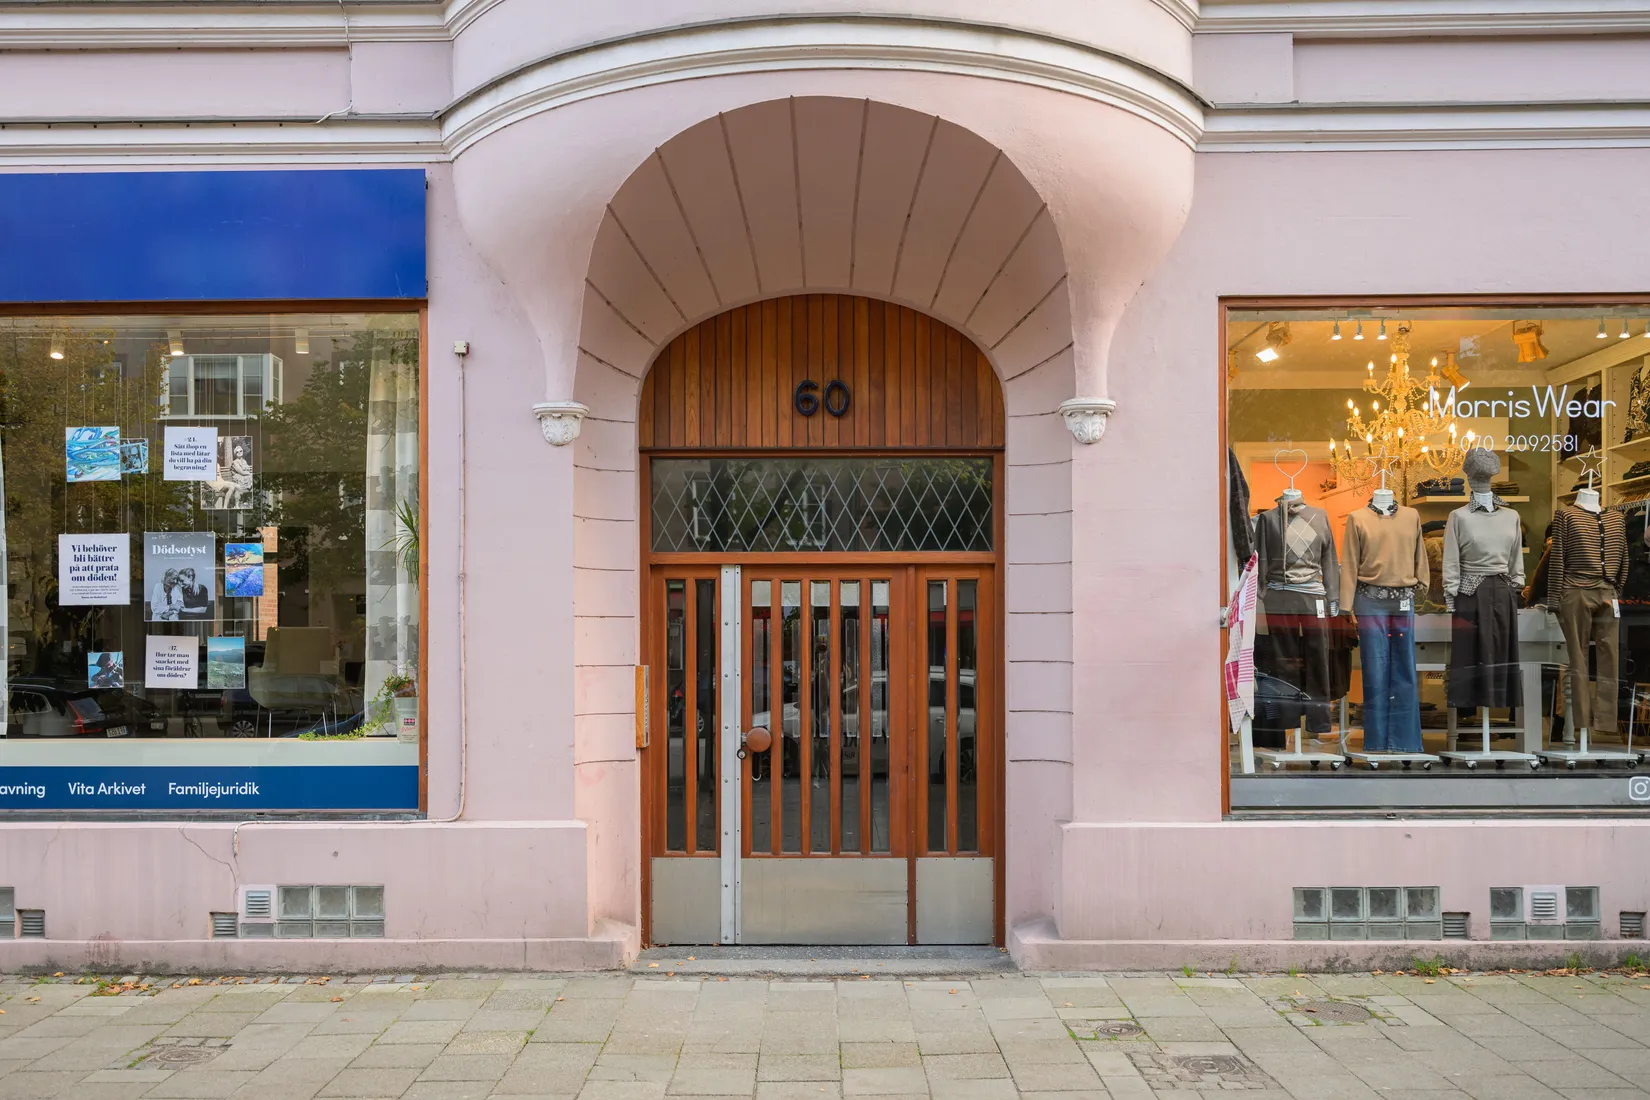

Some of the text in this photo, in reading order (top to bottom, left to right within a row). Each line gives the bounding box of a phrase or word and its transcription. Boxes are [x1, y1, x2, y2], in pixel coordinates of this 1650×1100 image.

[794, 379, 851, 417] 60
[1460, 434, 1578, 452] 070 2092581
[83, 544, 117, 552] behöver
[152, 544, 207, 556] Dödsotyst
[69, 564, 80, 573] på
[96, 565, 119, 573] prata
[0, 782, 46, 799] avning
[68, 782, 146, 795] Vita Arkivet
[168, 782, 260, 799] Familjejuridik
